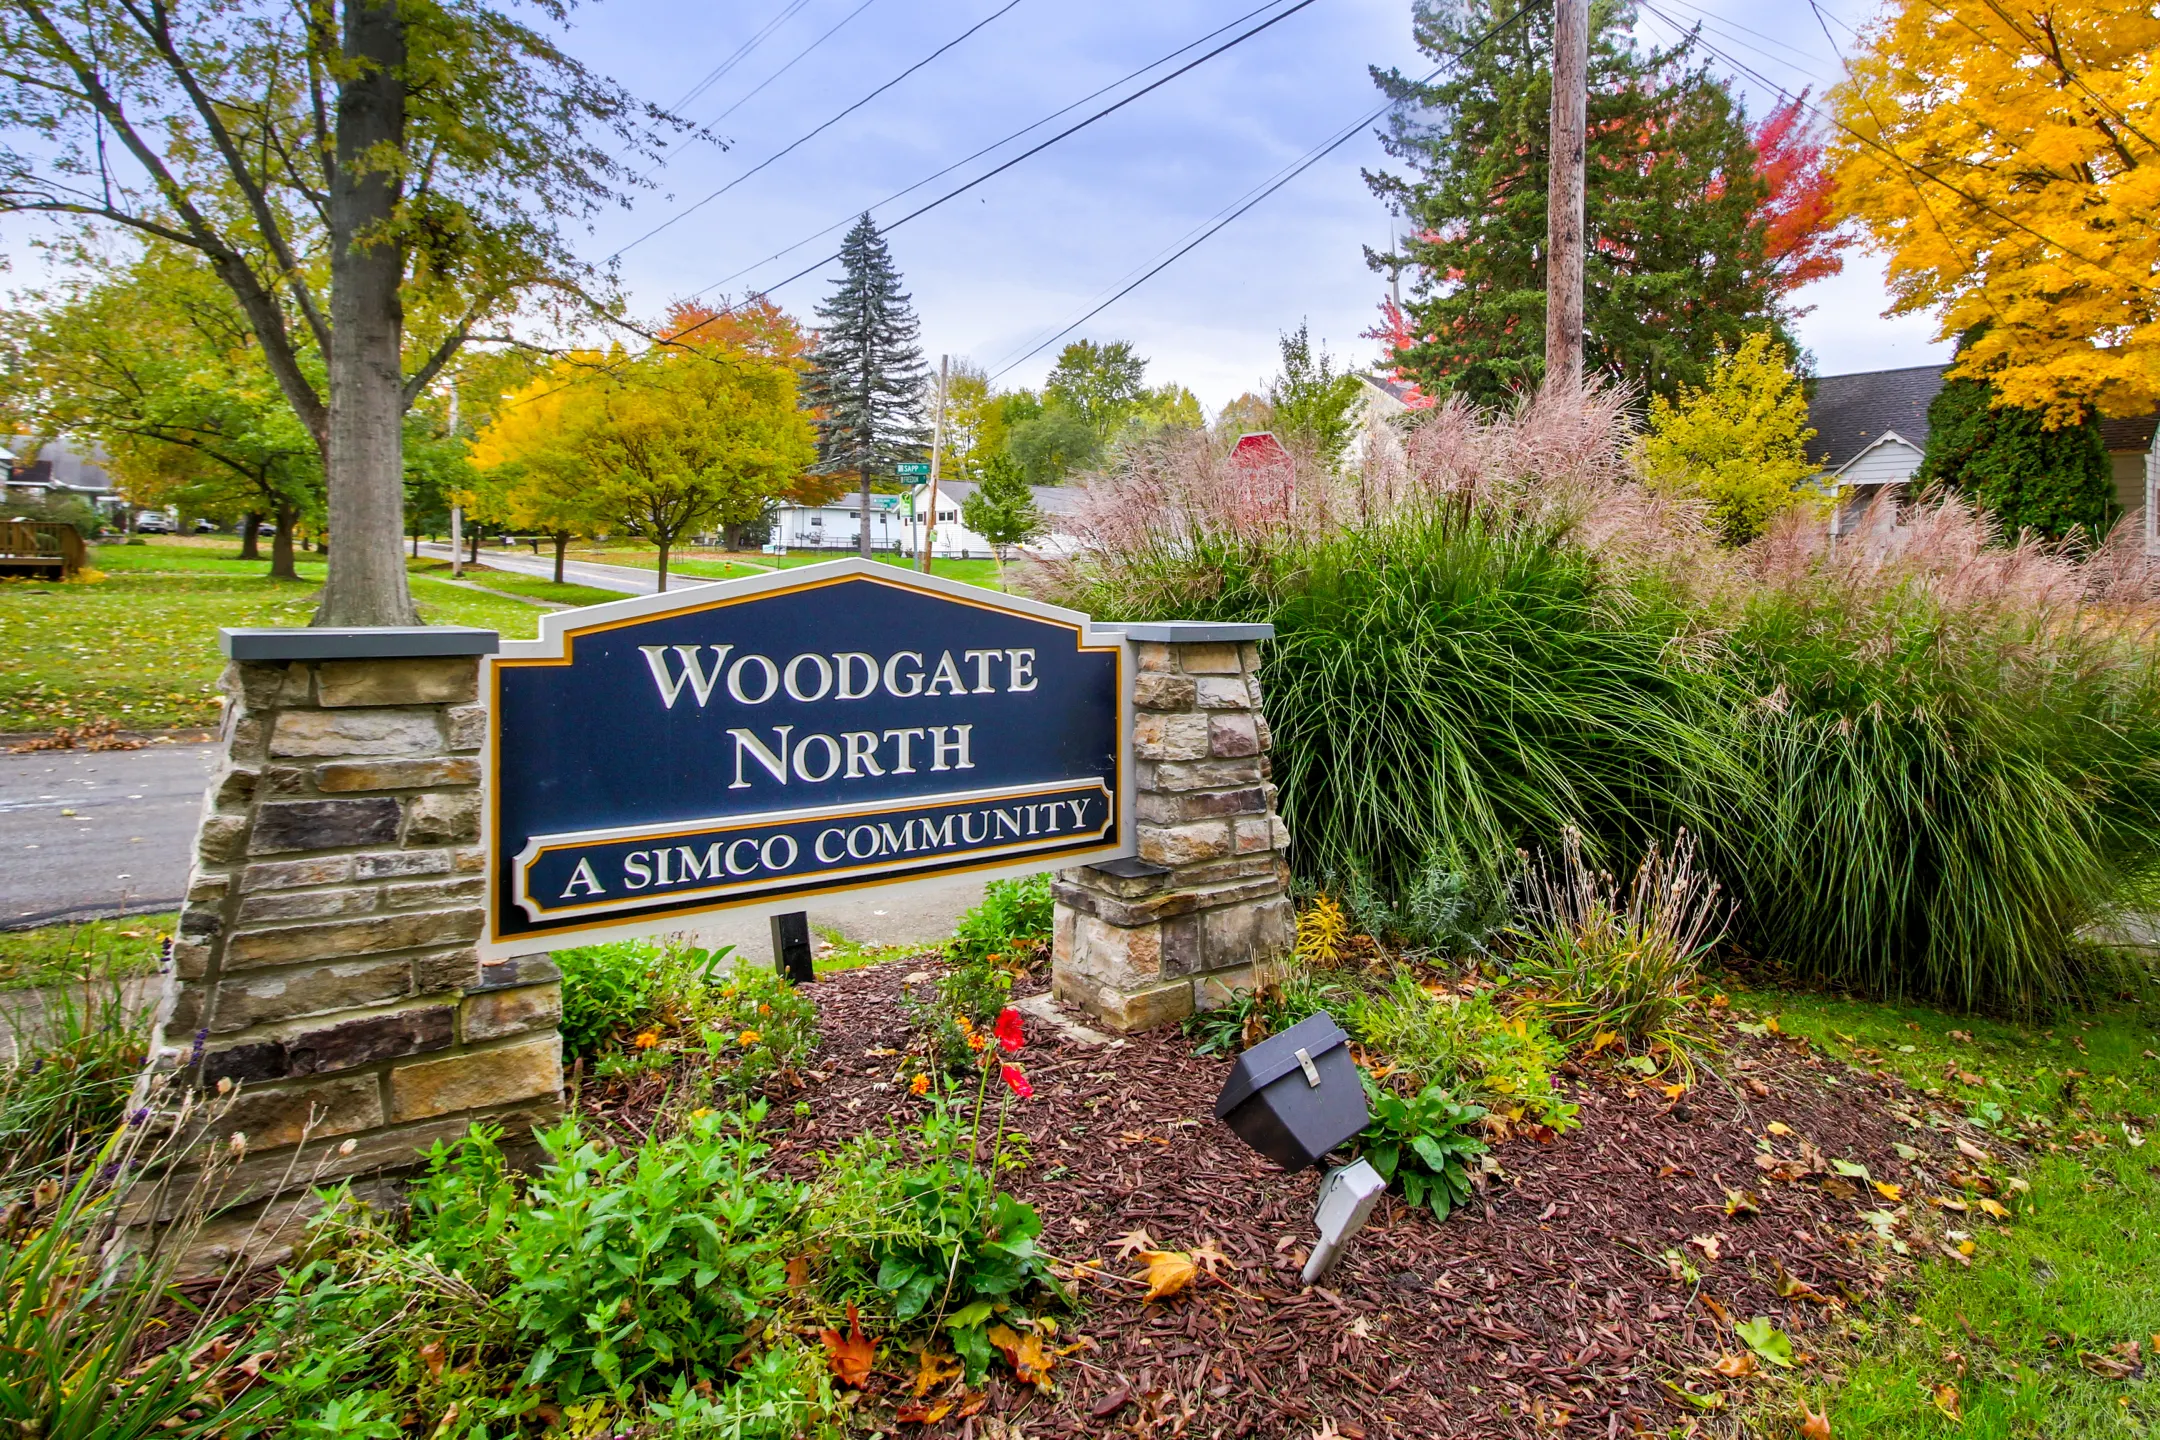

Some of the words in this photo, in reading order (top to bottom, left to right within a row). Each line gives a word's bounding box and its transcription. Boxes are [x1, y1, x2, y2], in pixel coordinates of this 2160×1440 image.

[637, 644, 1039, 710] WOODGATE
[725, 724, 976, 790] NORTH
[559, 857, 606, 899] A
[624, 834, 798, 890] SIMCO
[814, 797, 1091, 864] COMMUNITY
